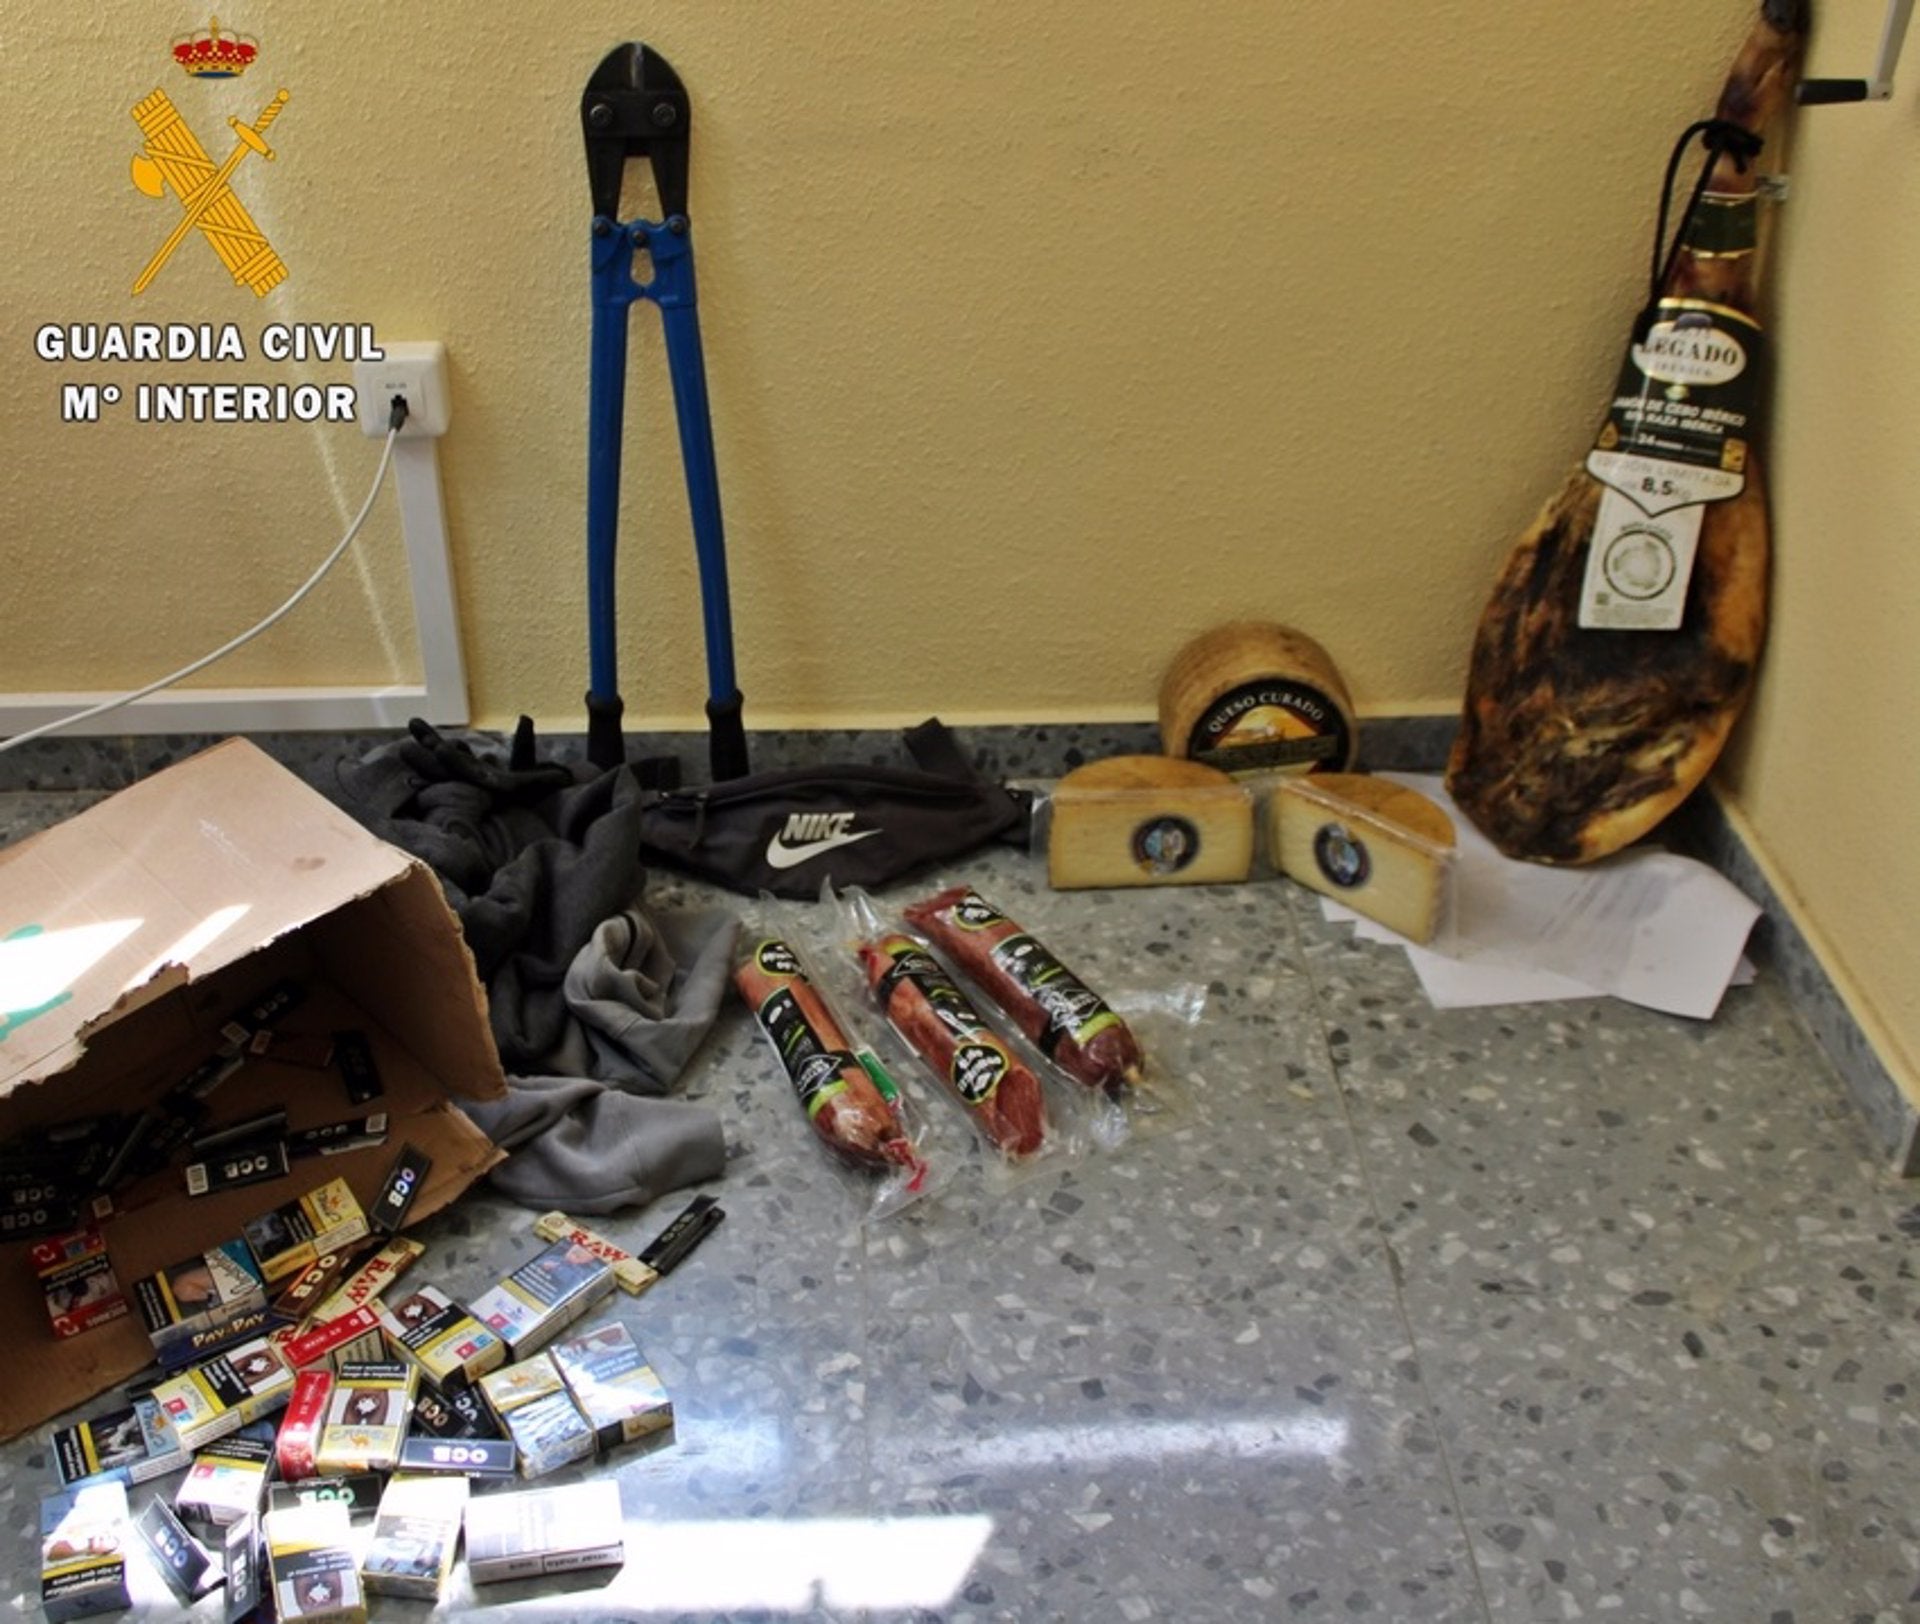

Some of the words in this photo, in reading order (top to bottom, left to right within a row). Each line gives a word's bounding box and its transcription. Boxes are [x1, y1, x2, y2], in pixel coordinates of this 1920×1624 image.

[1208, 695, 1256, 733] QUESO
[1259, 692, 1325, 720] CURADO
[782, 812, 855, 842] NIKE
[223, 1155, 269, 1179] OCB
[388, 1167, 416, 1207] OCB
[292, 1255, 337, 1298] OCB
[346, 1258, 392, 1305] RAW
[417, 1396, 449, 1427] OCB
[432, 1446, 489, 1464] OCB
[155, 1526, 188, 1568] OCB
[232, 1551, 247, 1602] OCB
